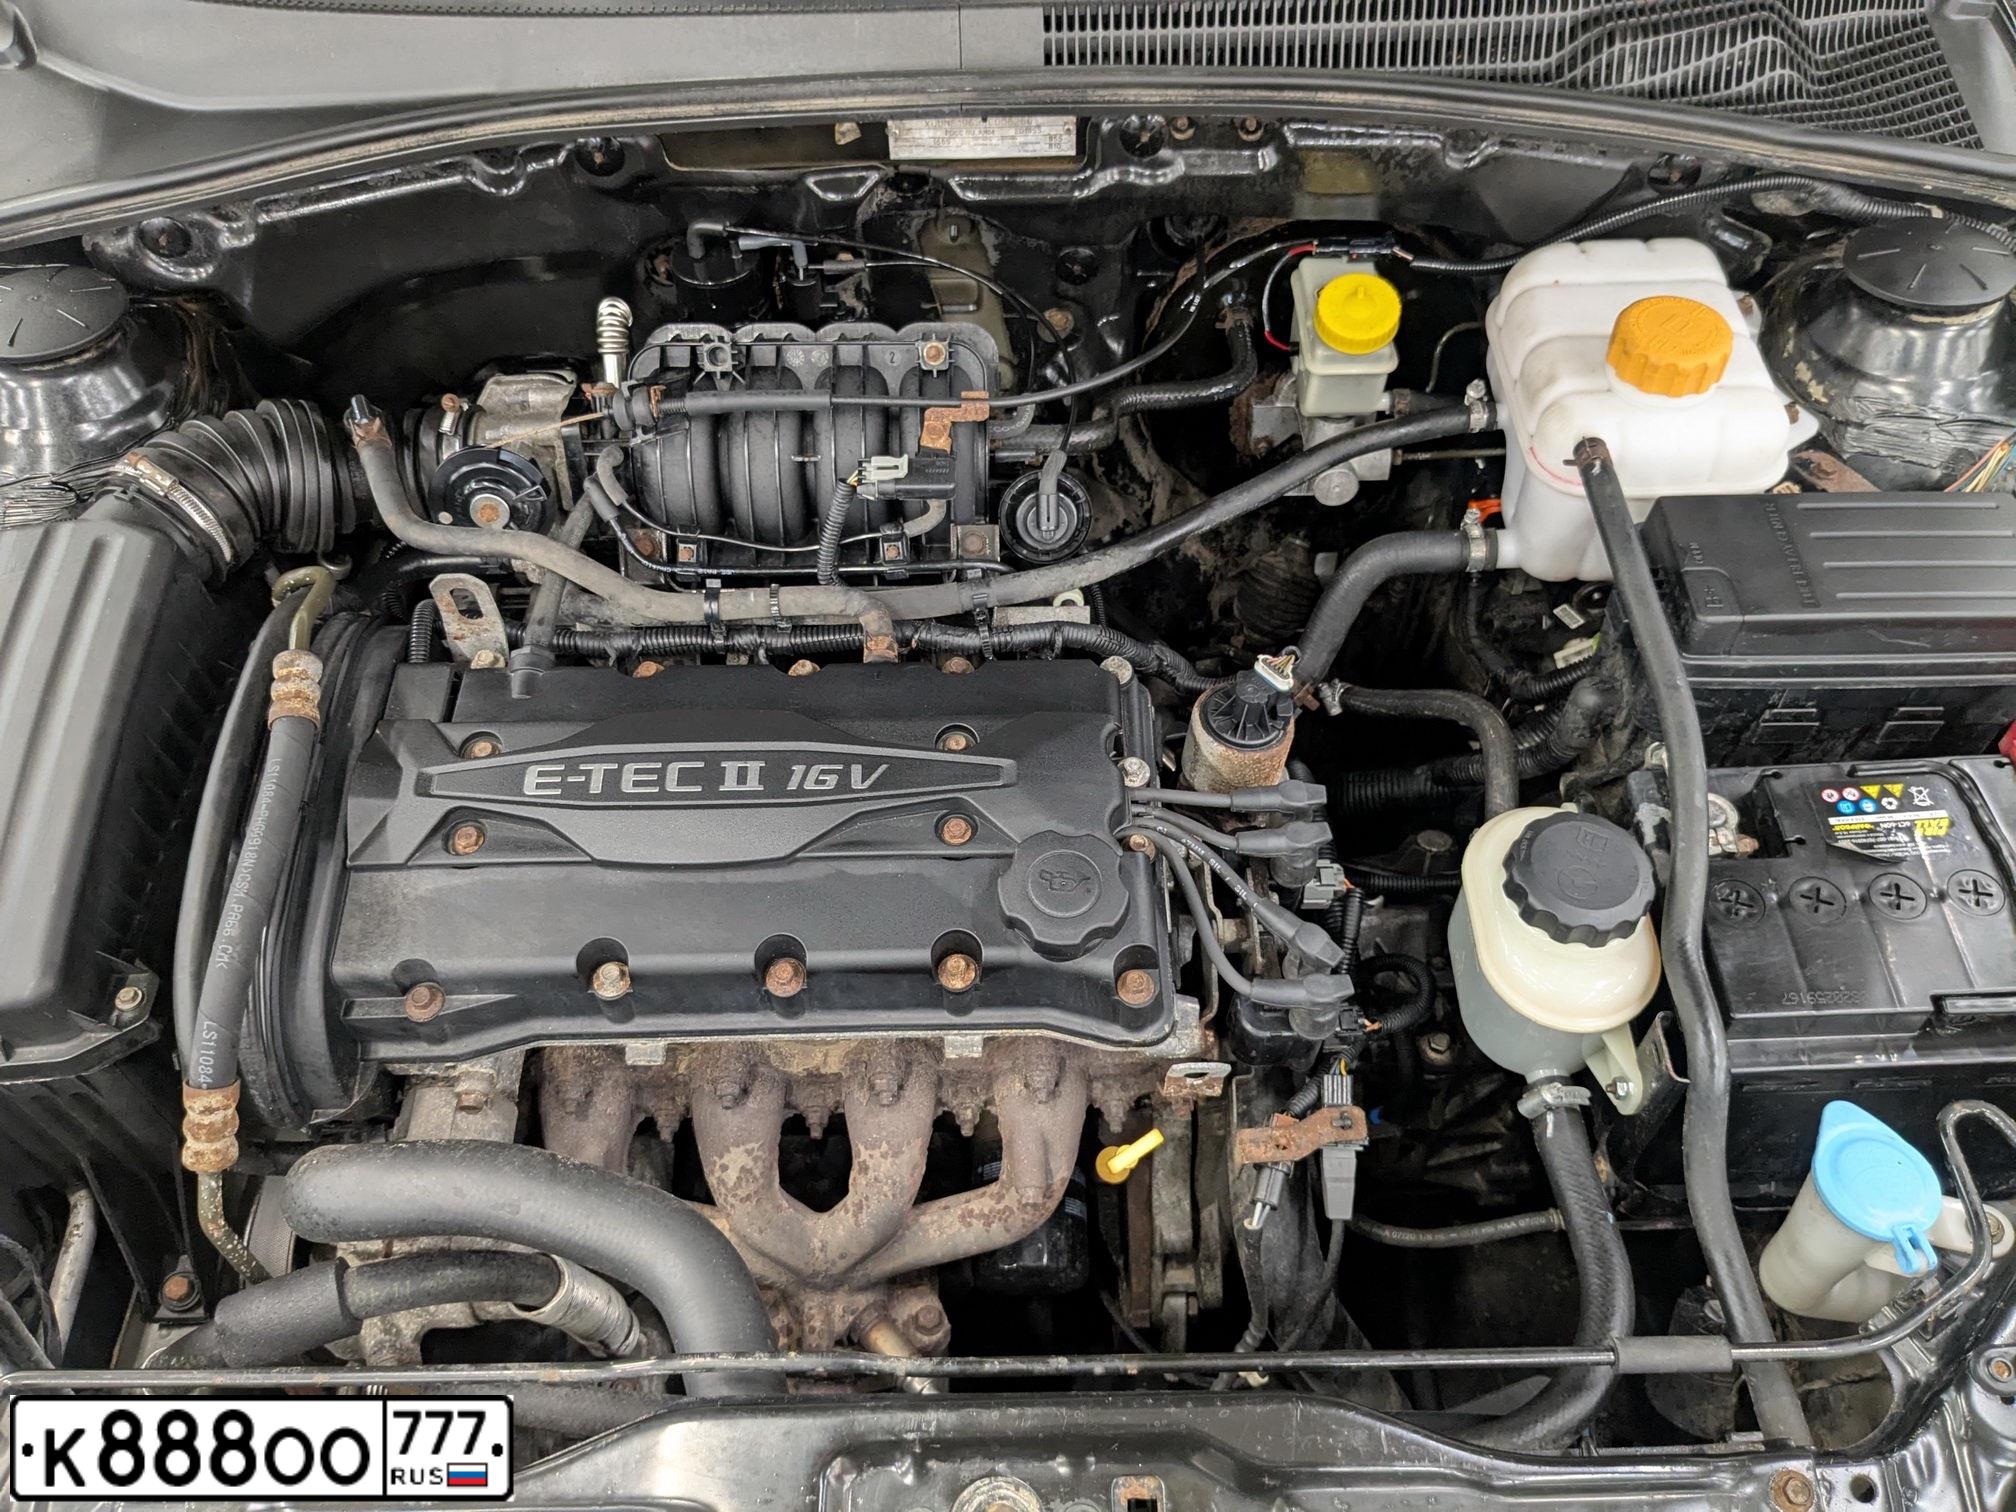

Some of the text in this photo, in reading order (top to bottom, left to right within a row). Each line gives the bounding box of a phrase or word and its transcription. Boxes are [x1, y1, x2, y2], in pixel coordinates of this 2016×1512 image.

[524, 760, 890, 795] E-TEC II 16V
